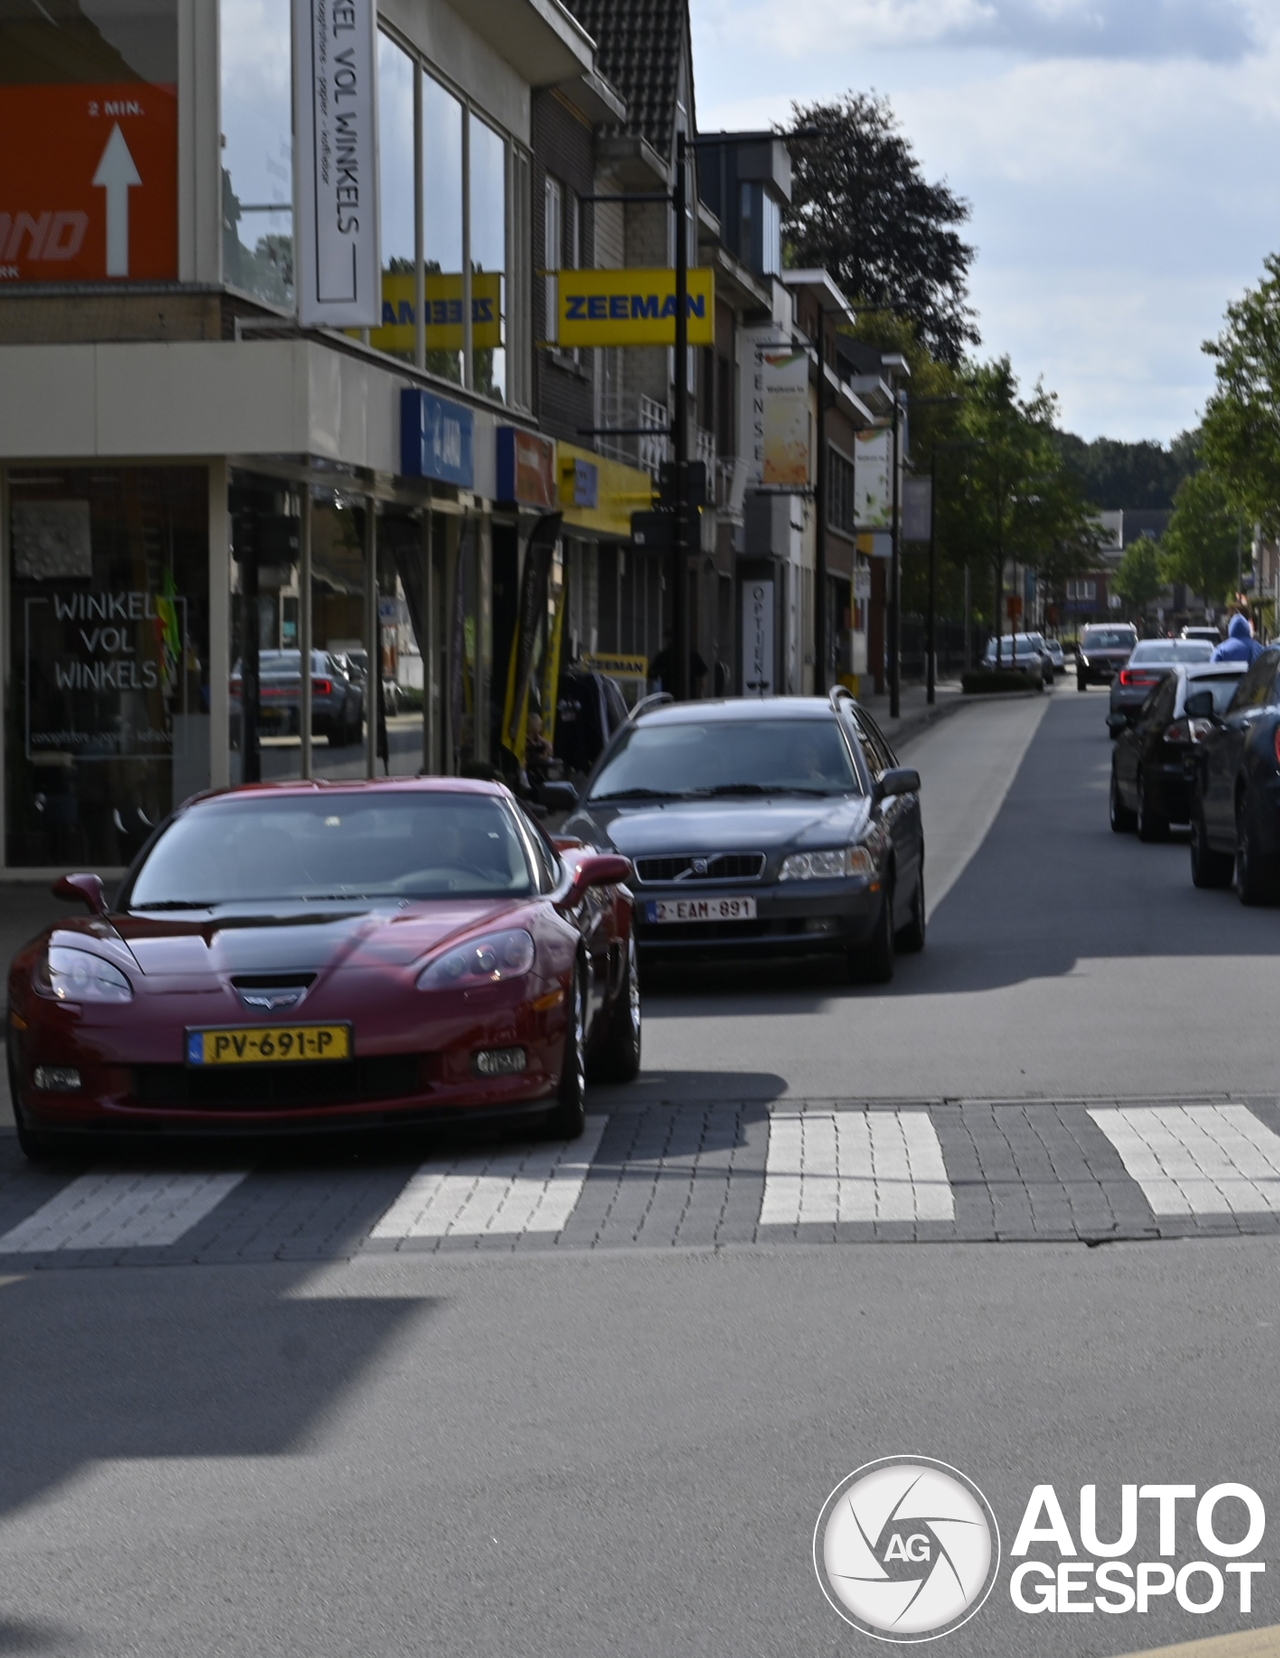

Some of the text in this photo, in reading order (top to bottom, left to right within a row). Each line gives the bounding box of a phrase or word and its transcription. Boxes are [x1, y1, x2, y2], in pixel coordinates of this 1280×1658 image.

[333, 47, 357, 104] VOL
[88, 100, 145, 116] 2 MIN.
[334, 111, 360, 235] WINKELS
[565, 294, 706, 321] ZEEMAN
[53, 591, 158, 621] WINKEL
[78, 626, 136, 654] VOL
[54, 659, 158, 690] WINKELS
[214, 1031, 333, 1059] PV-691-P
